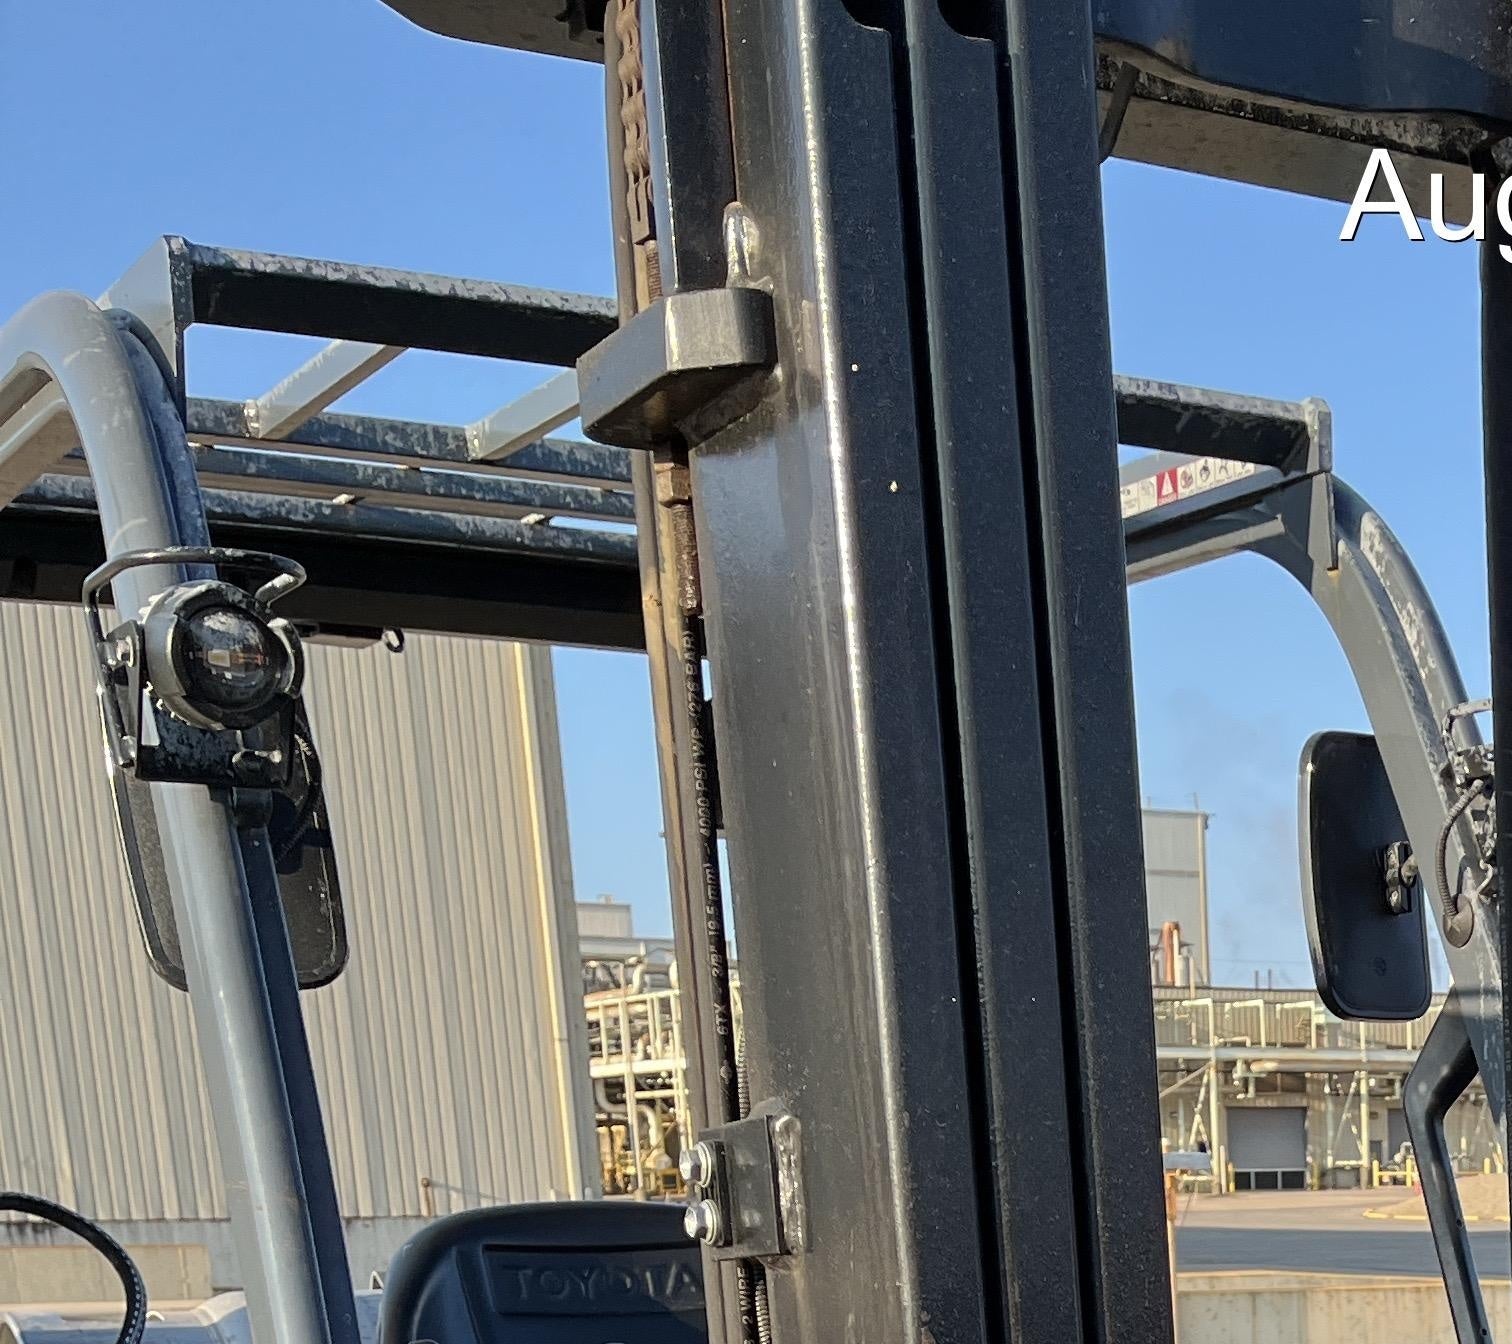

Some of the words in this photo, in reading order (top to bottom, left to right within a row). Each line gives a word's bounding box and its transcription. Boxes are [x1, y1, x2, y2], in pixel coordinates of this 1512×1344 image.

[502, 1263, 699, 1301] TOYOTA
[735, 1266, 753, 1311] WIRE
[741, 1313, 753, 1324] 2
